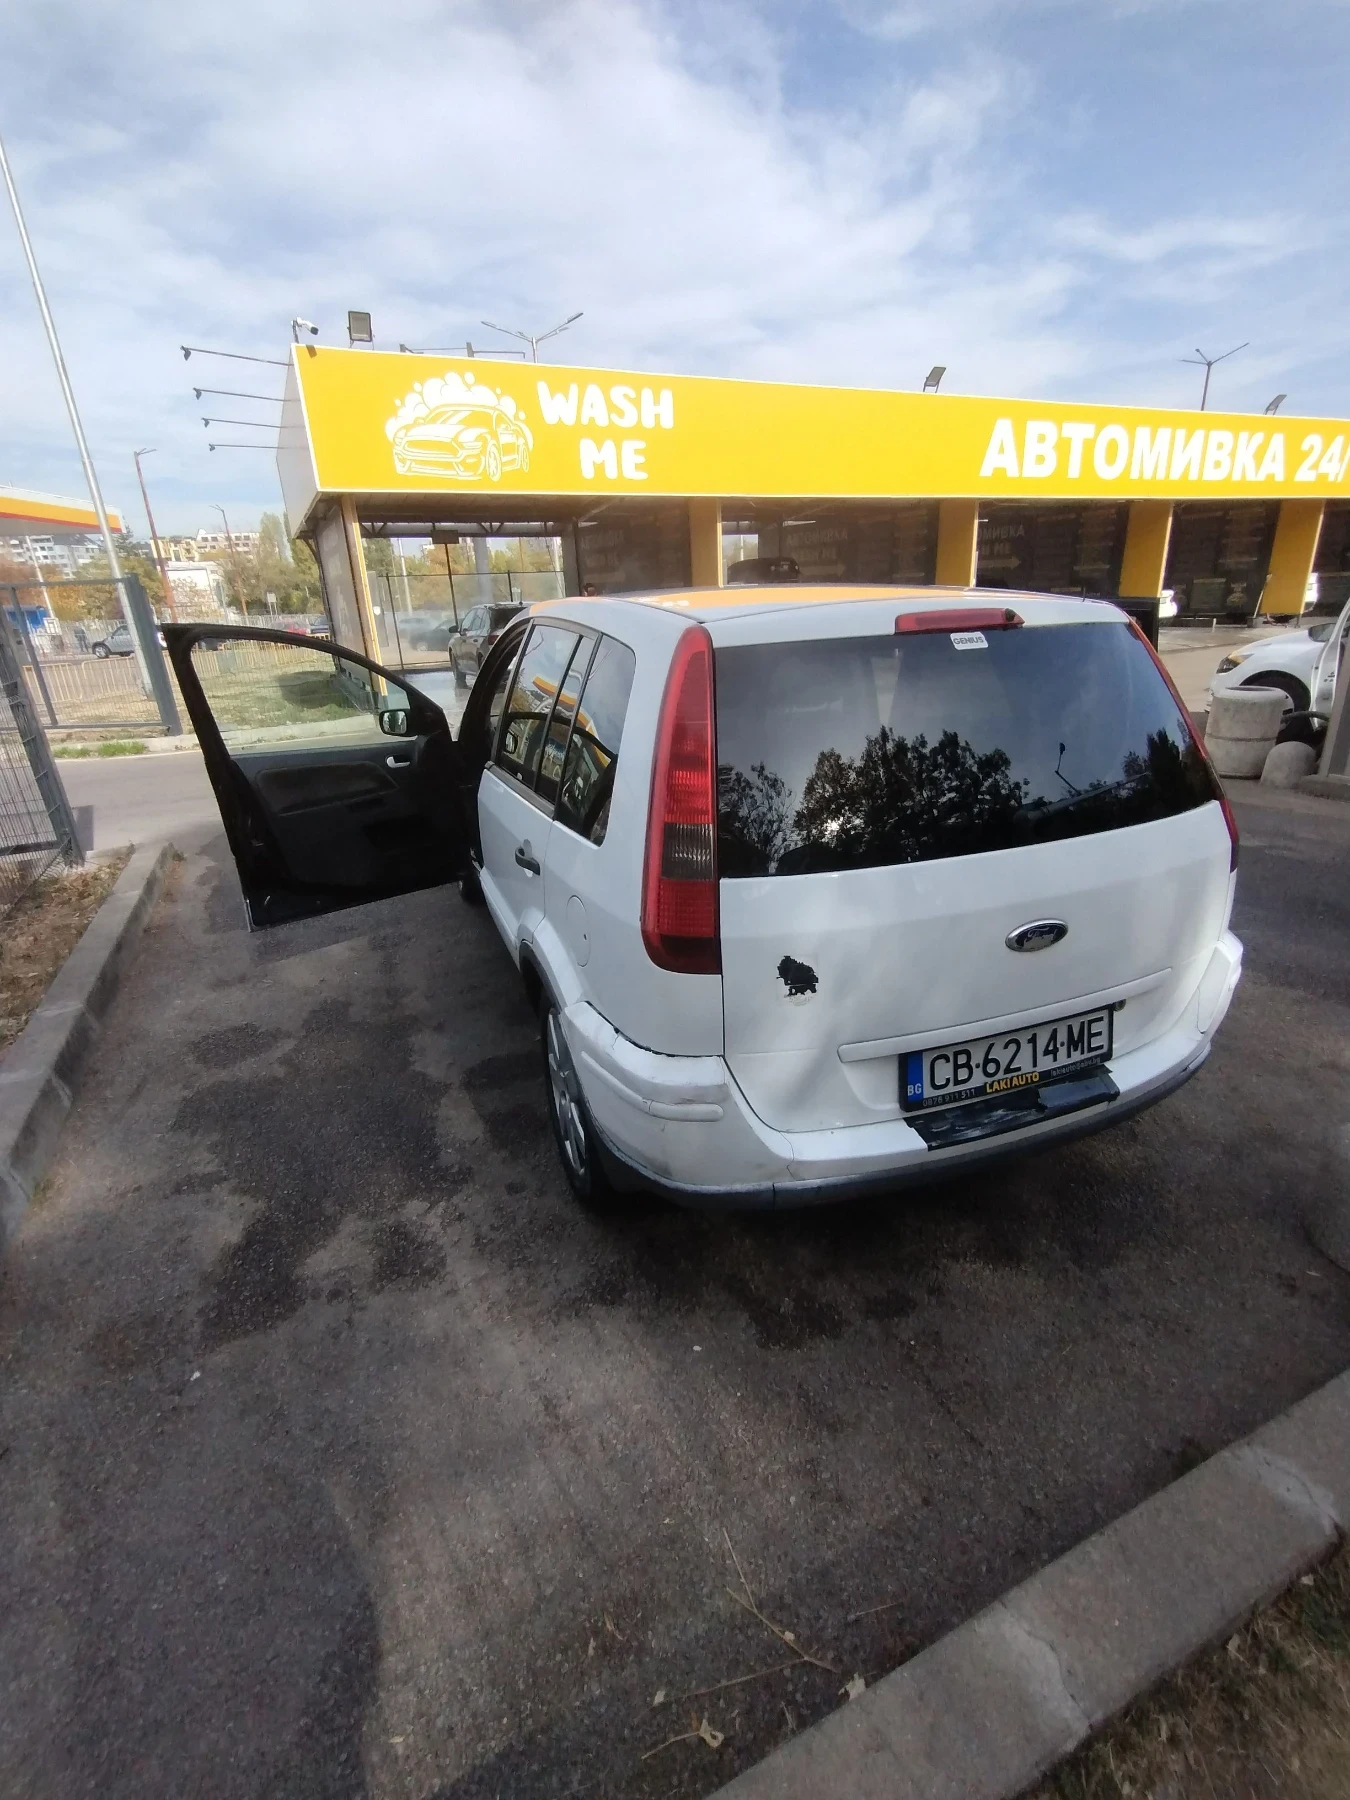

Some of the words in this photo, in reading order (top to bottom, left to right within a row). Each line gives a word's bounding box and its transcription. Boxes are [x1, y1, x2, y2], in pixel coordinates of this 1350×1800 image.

[537, 380, 674, 429] WASH
[579, 437, 649, 480] ME
[979, 418, 1285, 482] АВТОМИВКА
[953, 637, 984, 645] GENIUS
[907, 1083, 922, 1096] BG
[1012, 1071, 1040, 1087] AUTO
